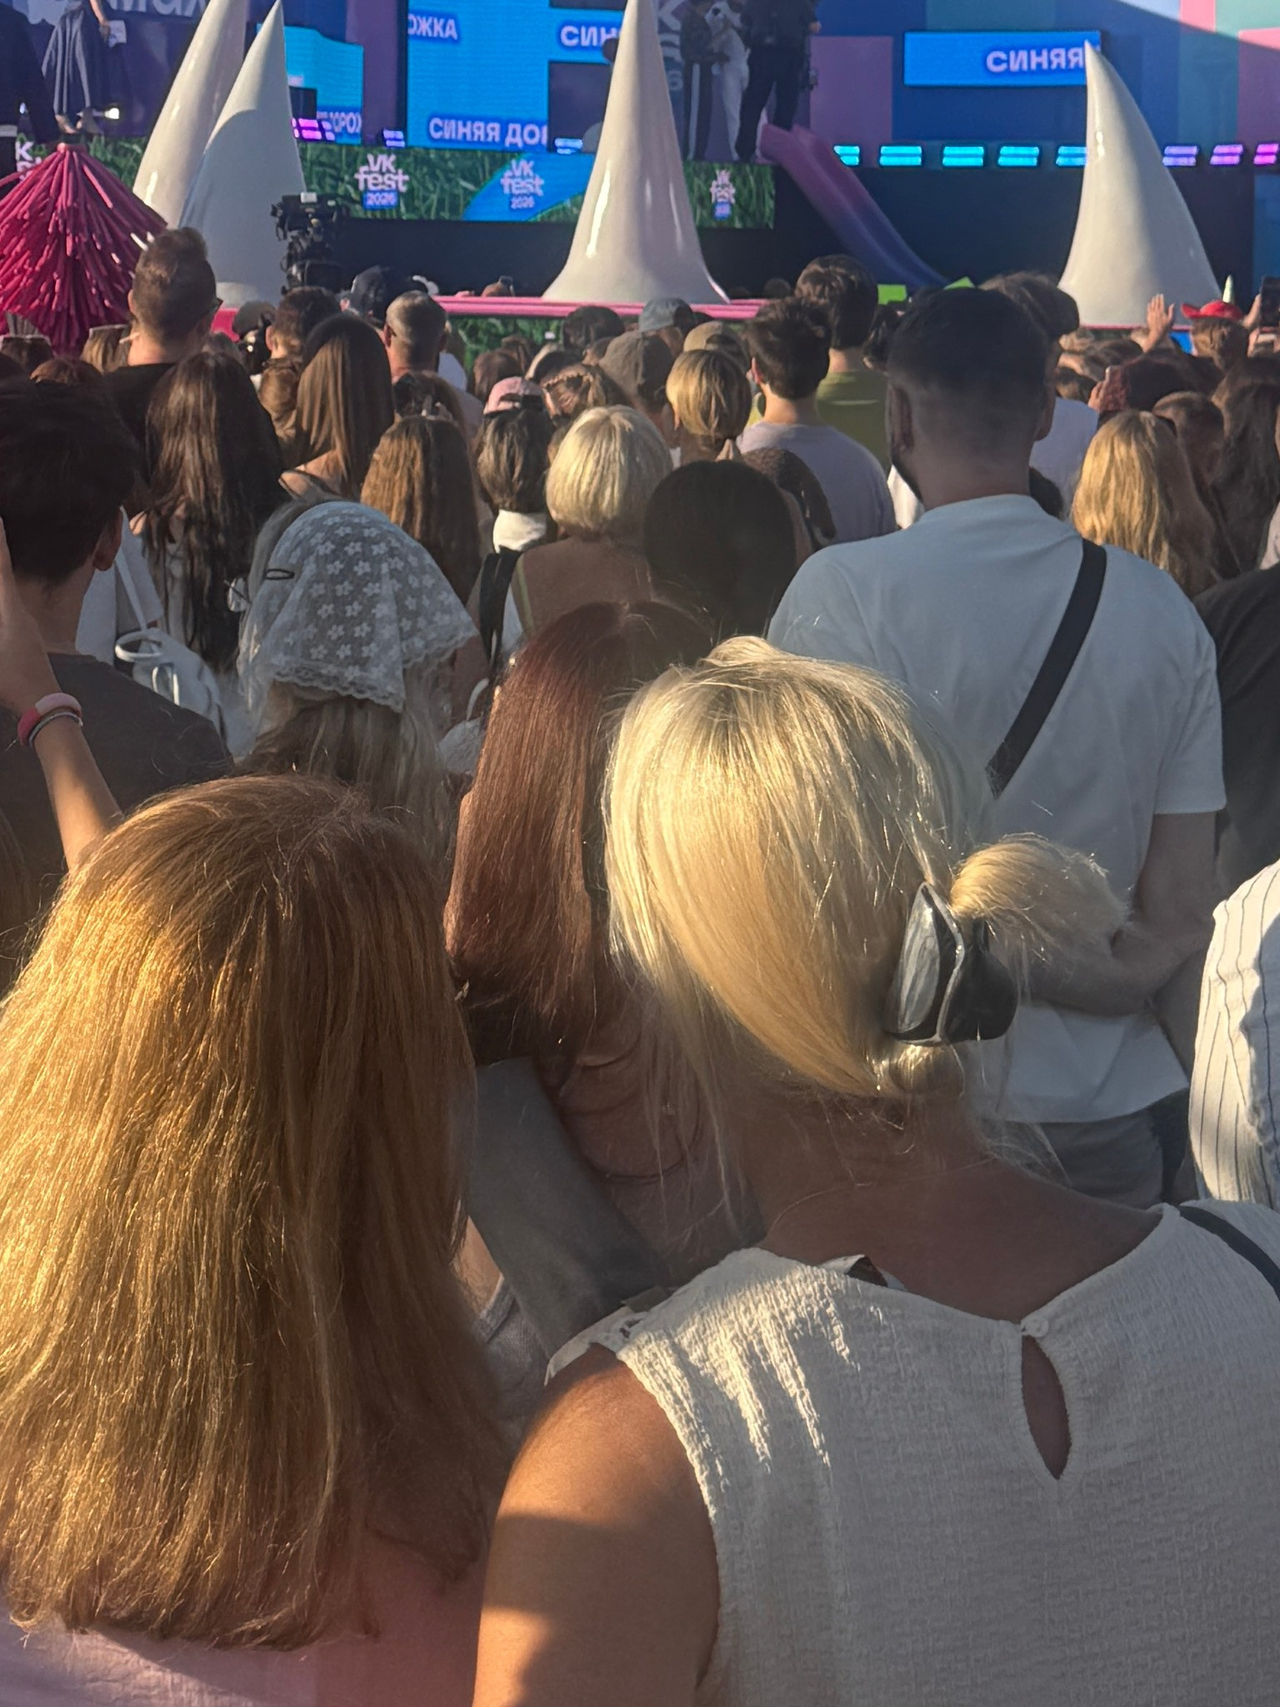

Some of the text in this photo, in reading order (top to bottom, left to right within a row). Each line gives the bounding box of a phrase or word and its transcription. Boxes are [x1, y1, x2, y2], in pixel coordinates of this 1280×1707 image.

[986, 47, 1084, 72] СИНЯЯ
[429, 117, 500, 143] СИНЯЯ
[15, 141, 34, 162] K
[367, 153, 396, 173] VK
[353, 165, 410, 193] fest
[511, 159, 535, 176] VK
[500, 170, 545, 197] fest
